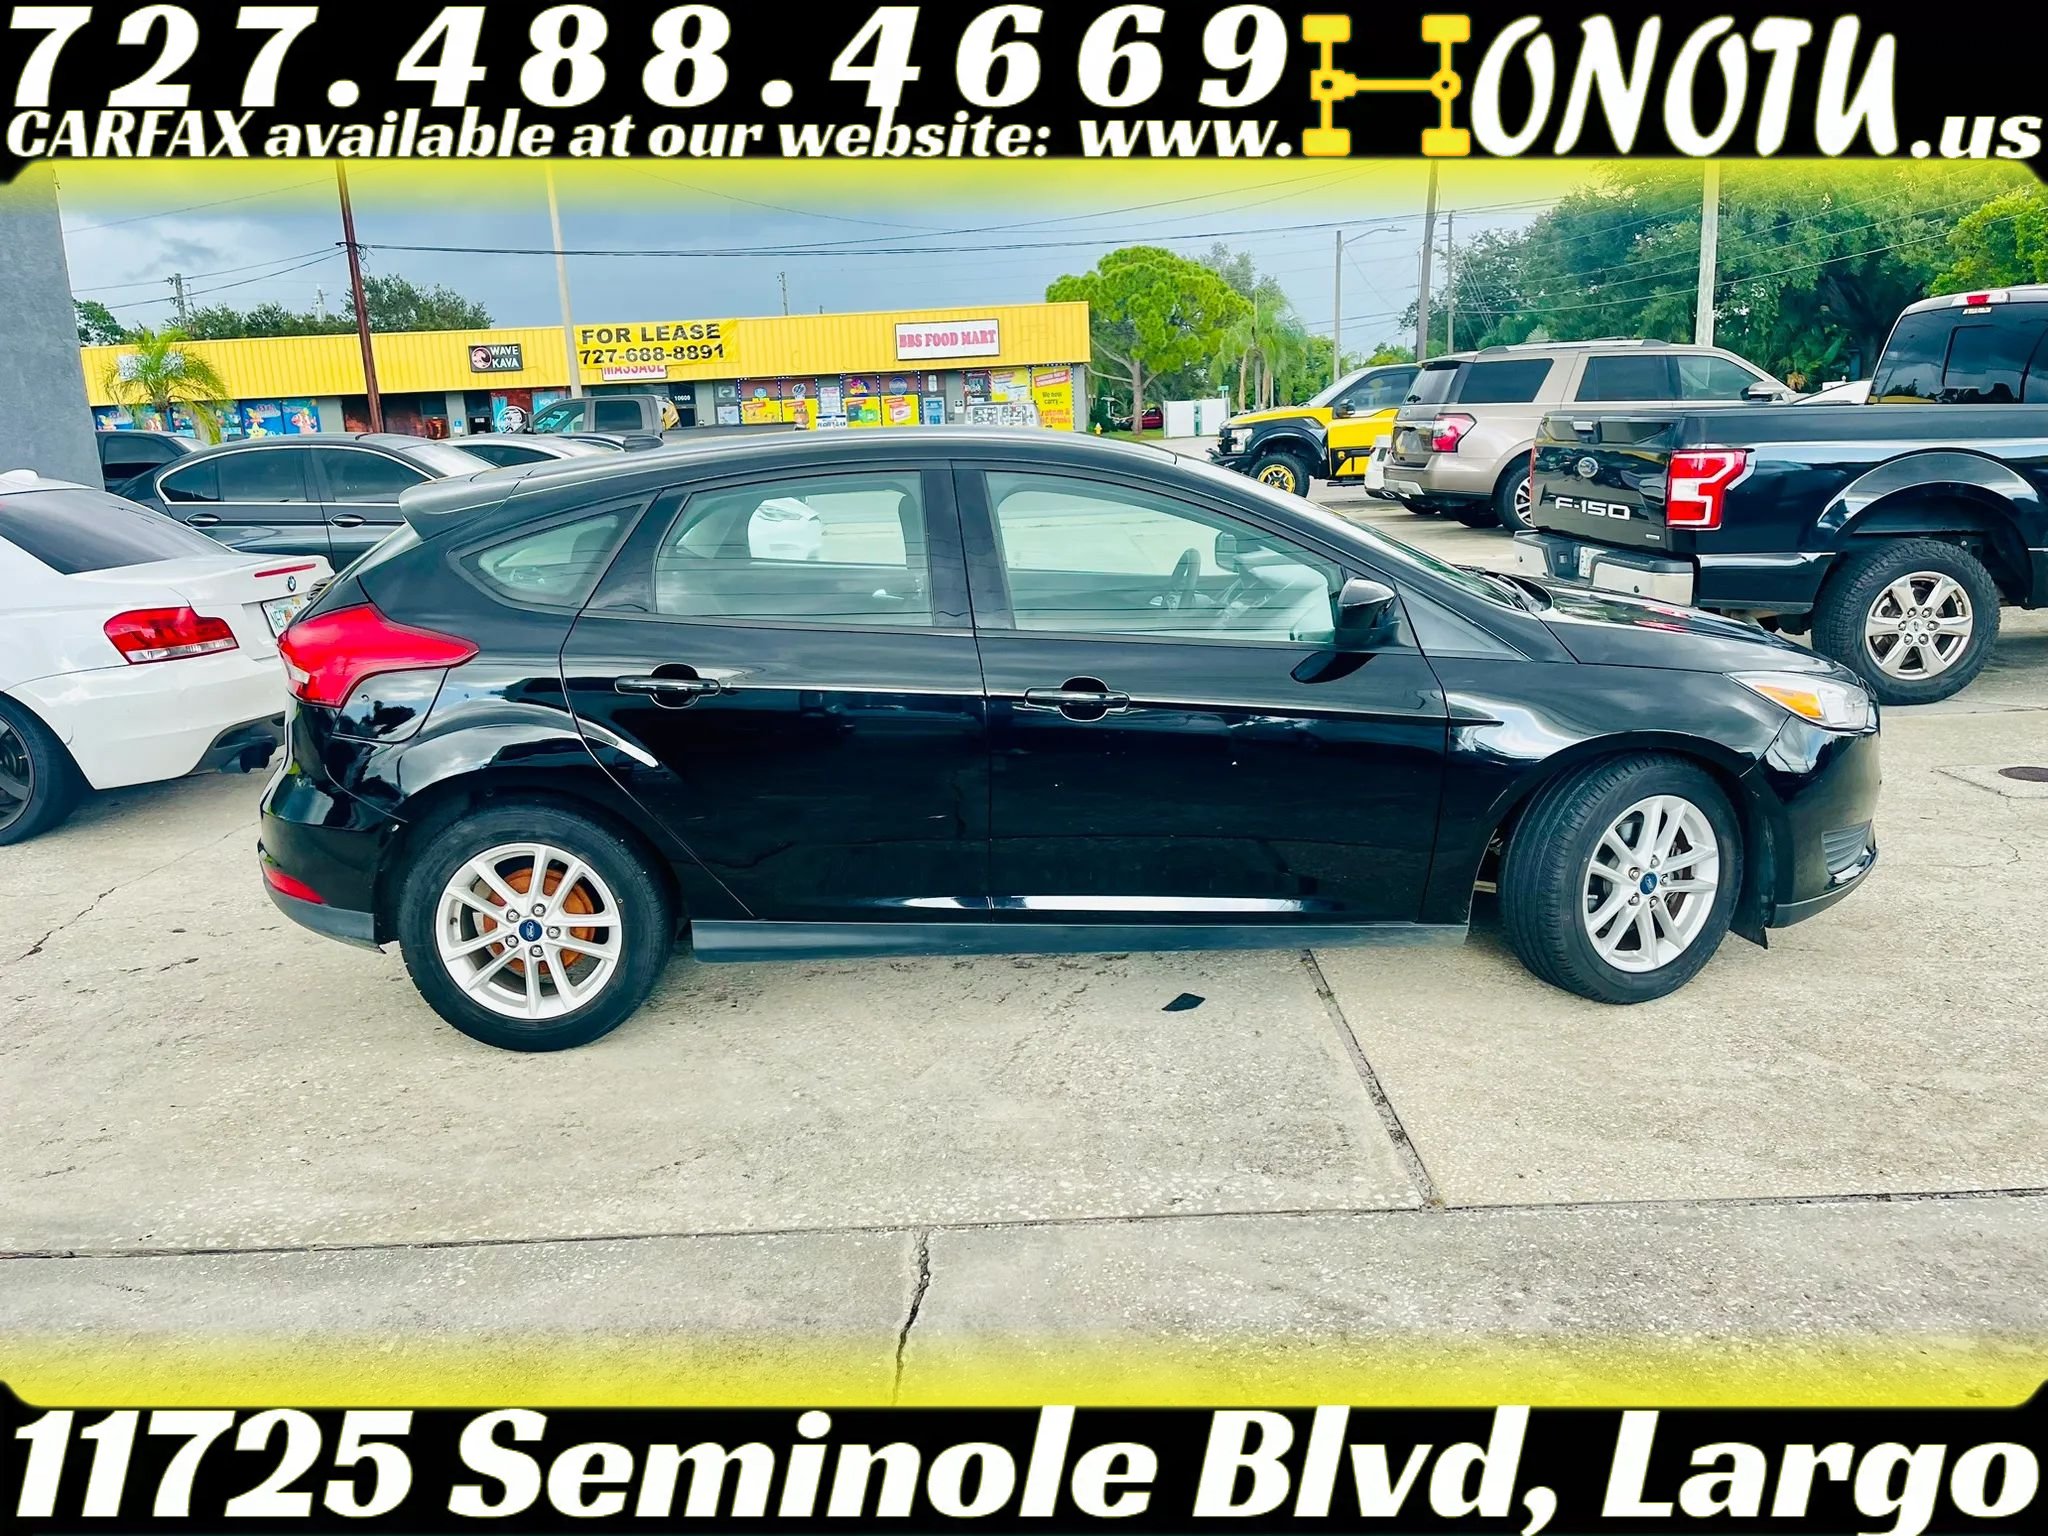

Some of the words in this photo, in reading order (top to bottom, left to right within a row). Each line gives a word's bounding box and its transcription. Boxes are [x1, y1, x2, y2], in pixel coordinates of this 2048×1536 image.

[582, 327, 631, 345] FOR
[641, 323, 721, 342] LEASE
[898, 334, 923, 348] BBS
[925, 332, 959, 347] FOOD
[961, 329, 997, 345] MART
[490, 345, 519, 355] WAVE
[579, 343, 724, 364] 727-688-8891
[492, 357, 519, 368] KAVA
[1555, 496, 1630, 521] F-150
